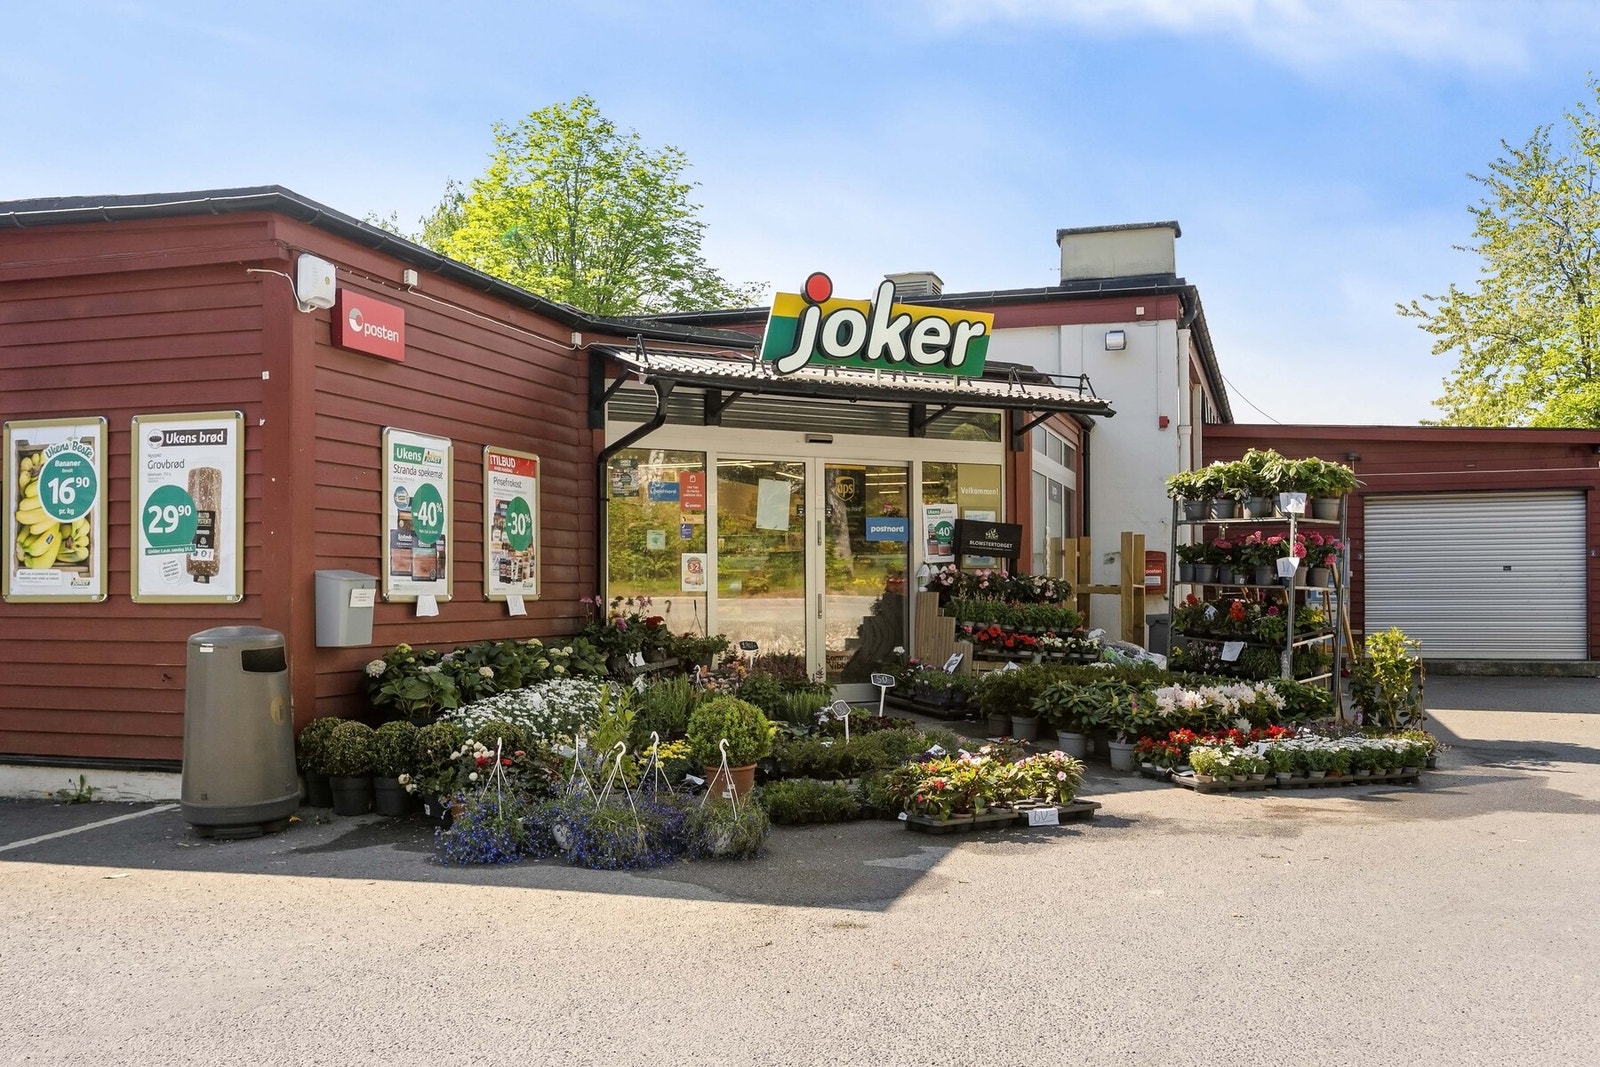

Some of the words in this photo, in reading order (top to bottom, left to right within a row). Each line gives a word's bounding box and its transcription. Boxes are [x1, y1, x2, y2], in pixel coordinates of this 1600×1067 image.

[773, 272, 987, 376] joker
[364, 323, 400, 343] posten
[165, 432, 198, 444] Ukens
[199, 430, 225, 443] brød
[45, 443, 70, 459] Ukens
[72, 441, 93, 459] Beste
[396, 447, 422, 462] Ukens
[54, 460, 82, 468] Bananer
[147, 459, 185, 470] Grovbrød
[492, 455, 516, 469] TILBUD
[393, 464, 418, 476] Stranda
[418, 468, 443, 480] spekemat
[493, 476, 523, 489] Pinsefrokost
[837, 483, 854, 498] ups
[960, 487, 999, 496] Velkommen!
[870, 525, 904, 534] postnord
[969, 540, 1013, 549] BLOMSTERTORGET
